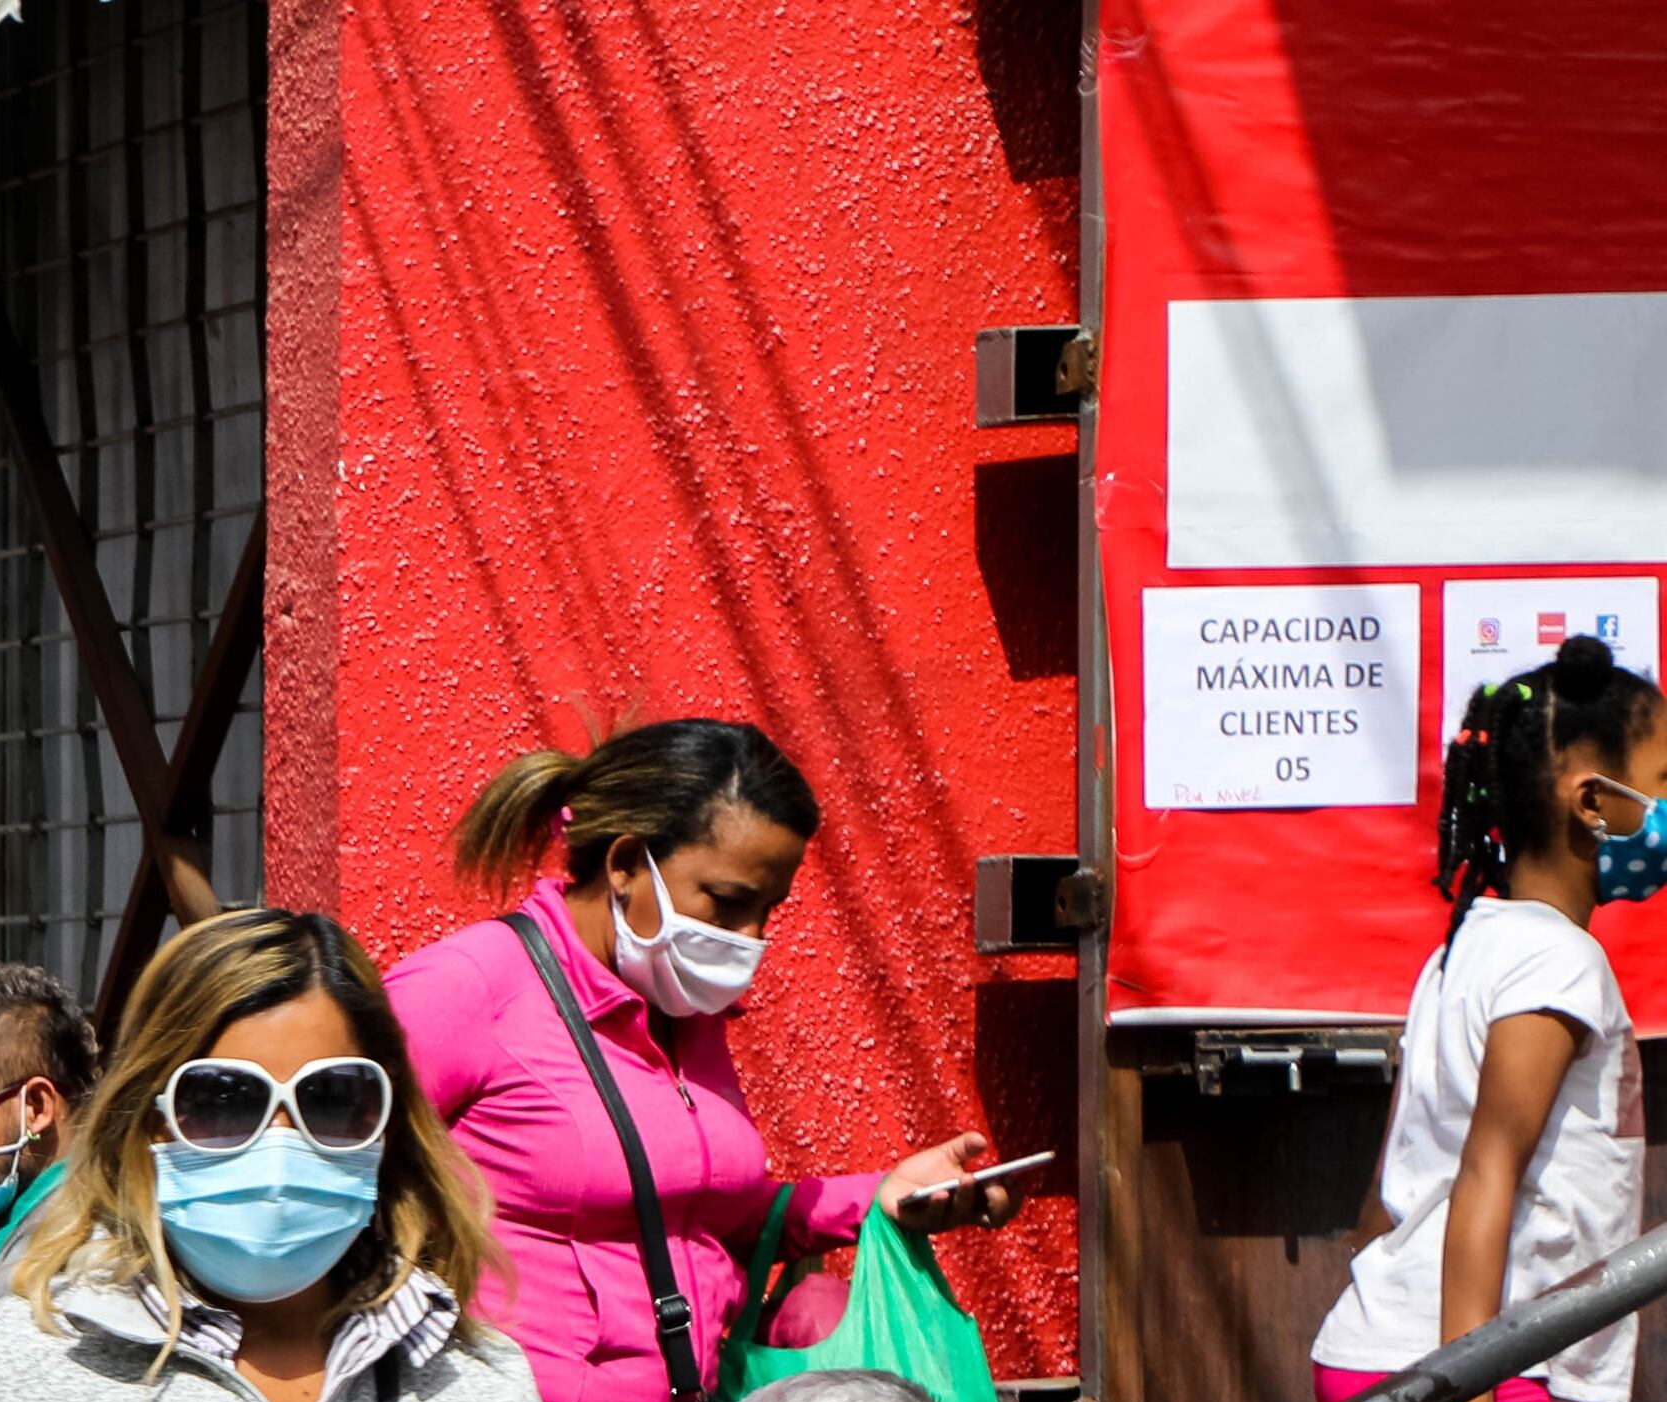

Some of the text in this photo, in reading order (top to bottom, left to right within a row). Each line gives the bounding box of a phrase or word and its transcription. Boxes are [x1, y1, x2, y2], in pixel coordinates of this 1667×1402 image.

[1200, 615, 1381, 644] CAPACIDAD
[1196, 658, 1384, 690] MÁXIMA DE
[1219, 709, 1359, 736] CLIENTES
[1275, 756, 1311, 782] 05
